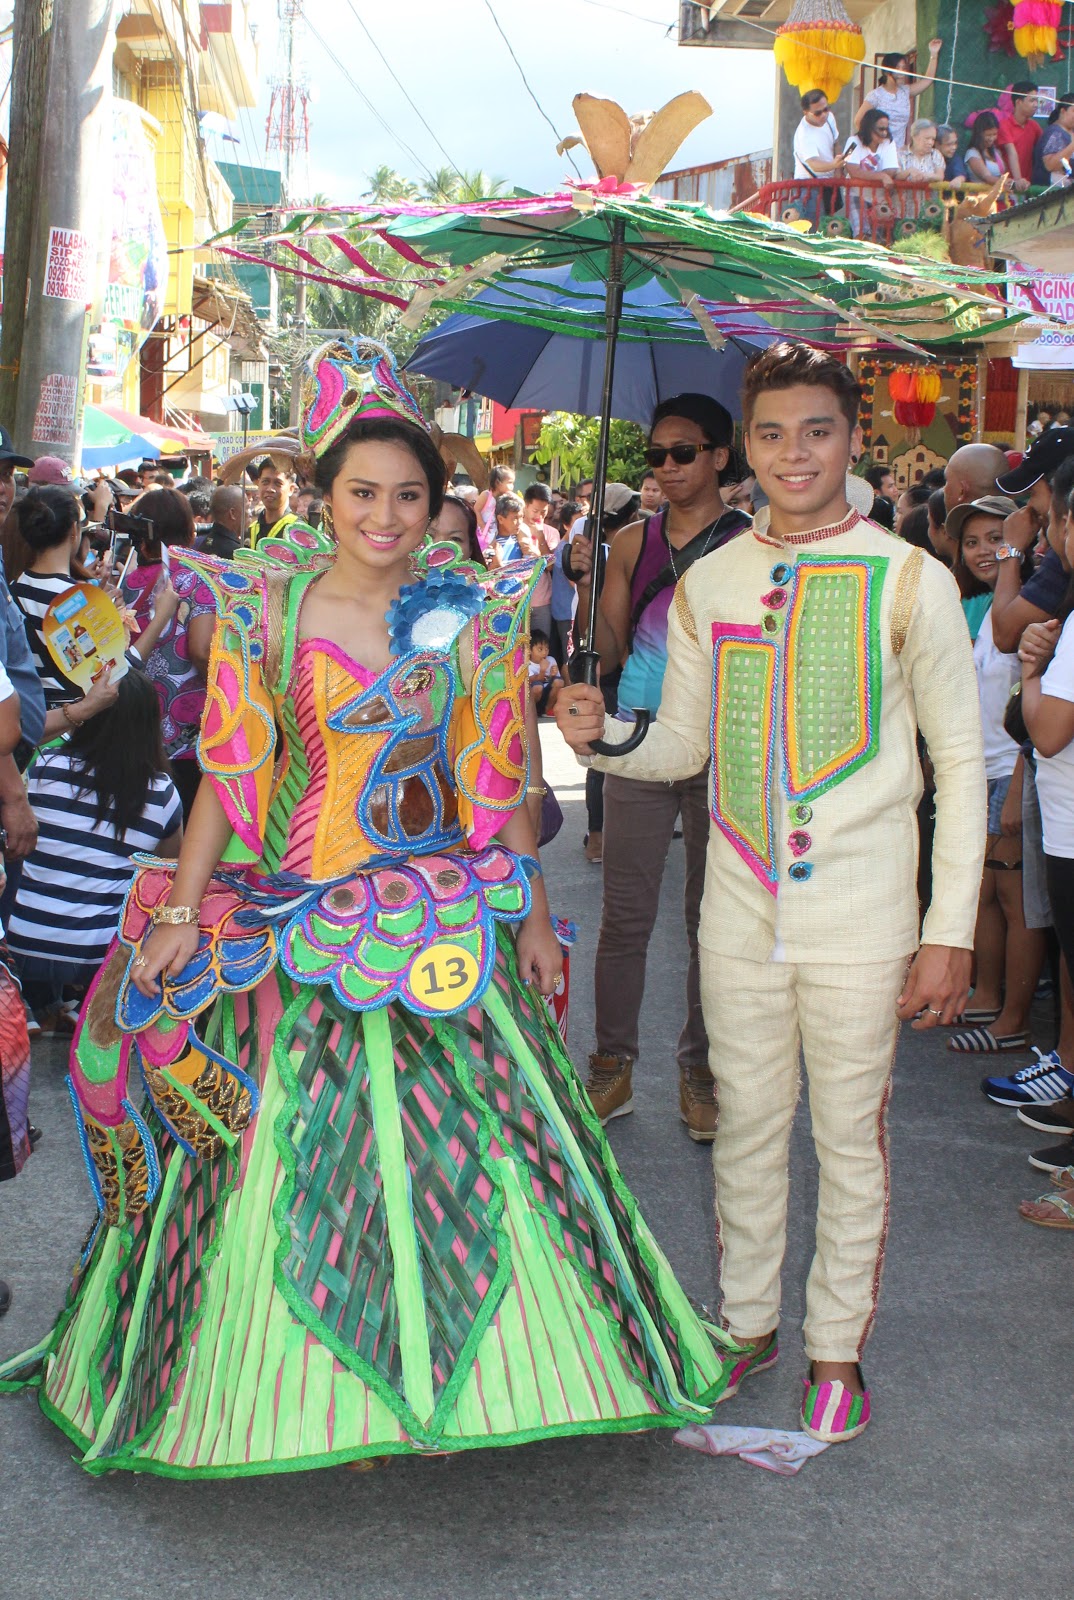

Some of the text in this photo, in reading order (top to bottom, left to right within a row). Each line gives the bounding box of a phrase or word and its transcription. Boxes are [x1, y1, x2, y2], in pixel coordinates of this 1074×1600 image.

[40, 393, 75, 405] ZONEGRO
[218, 436, 233, 445] ROAD
[222, 446, 230, 454] OF
[421, 957, 469, 995] 13
